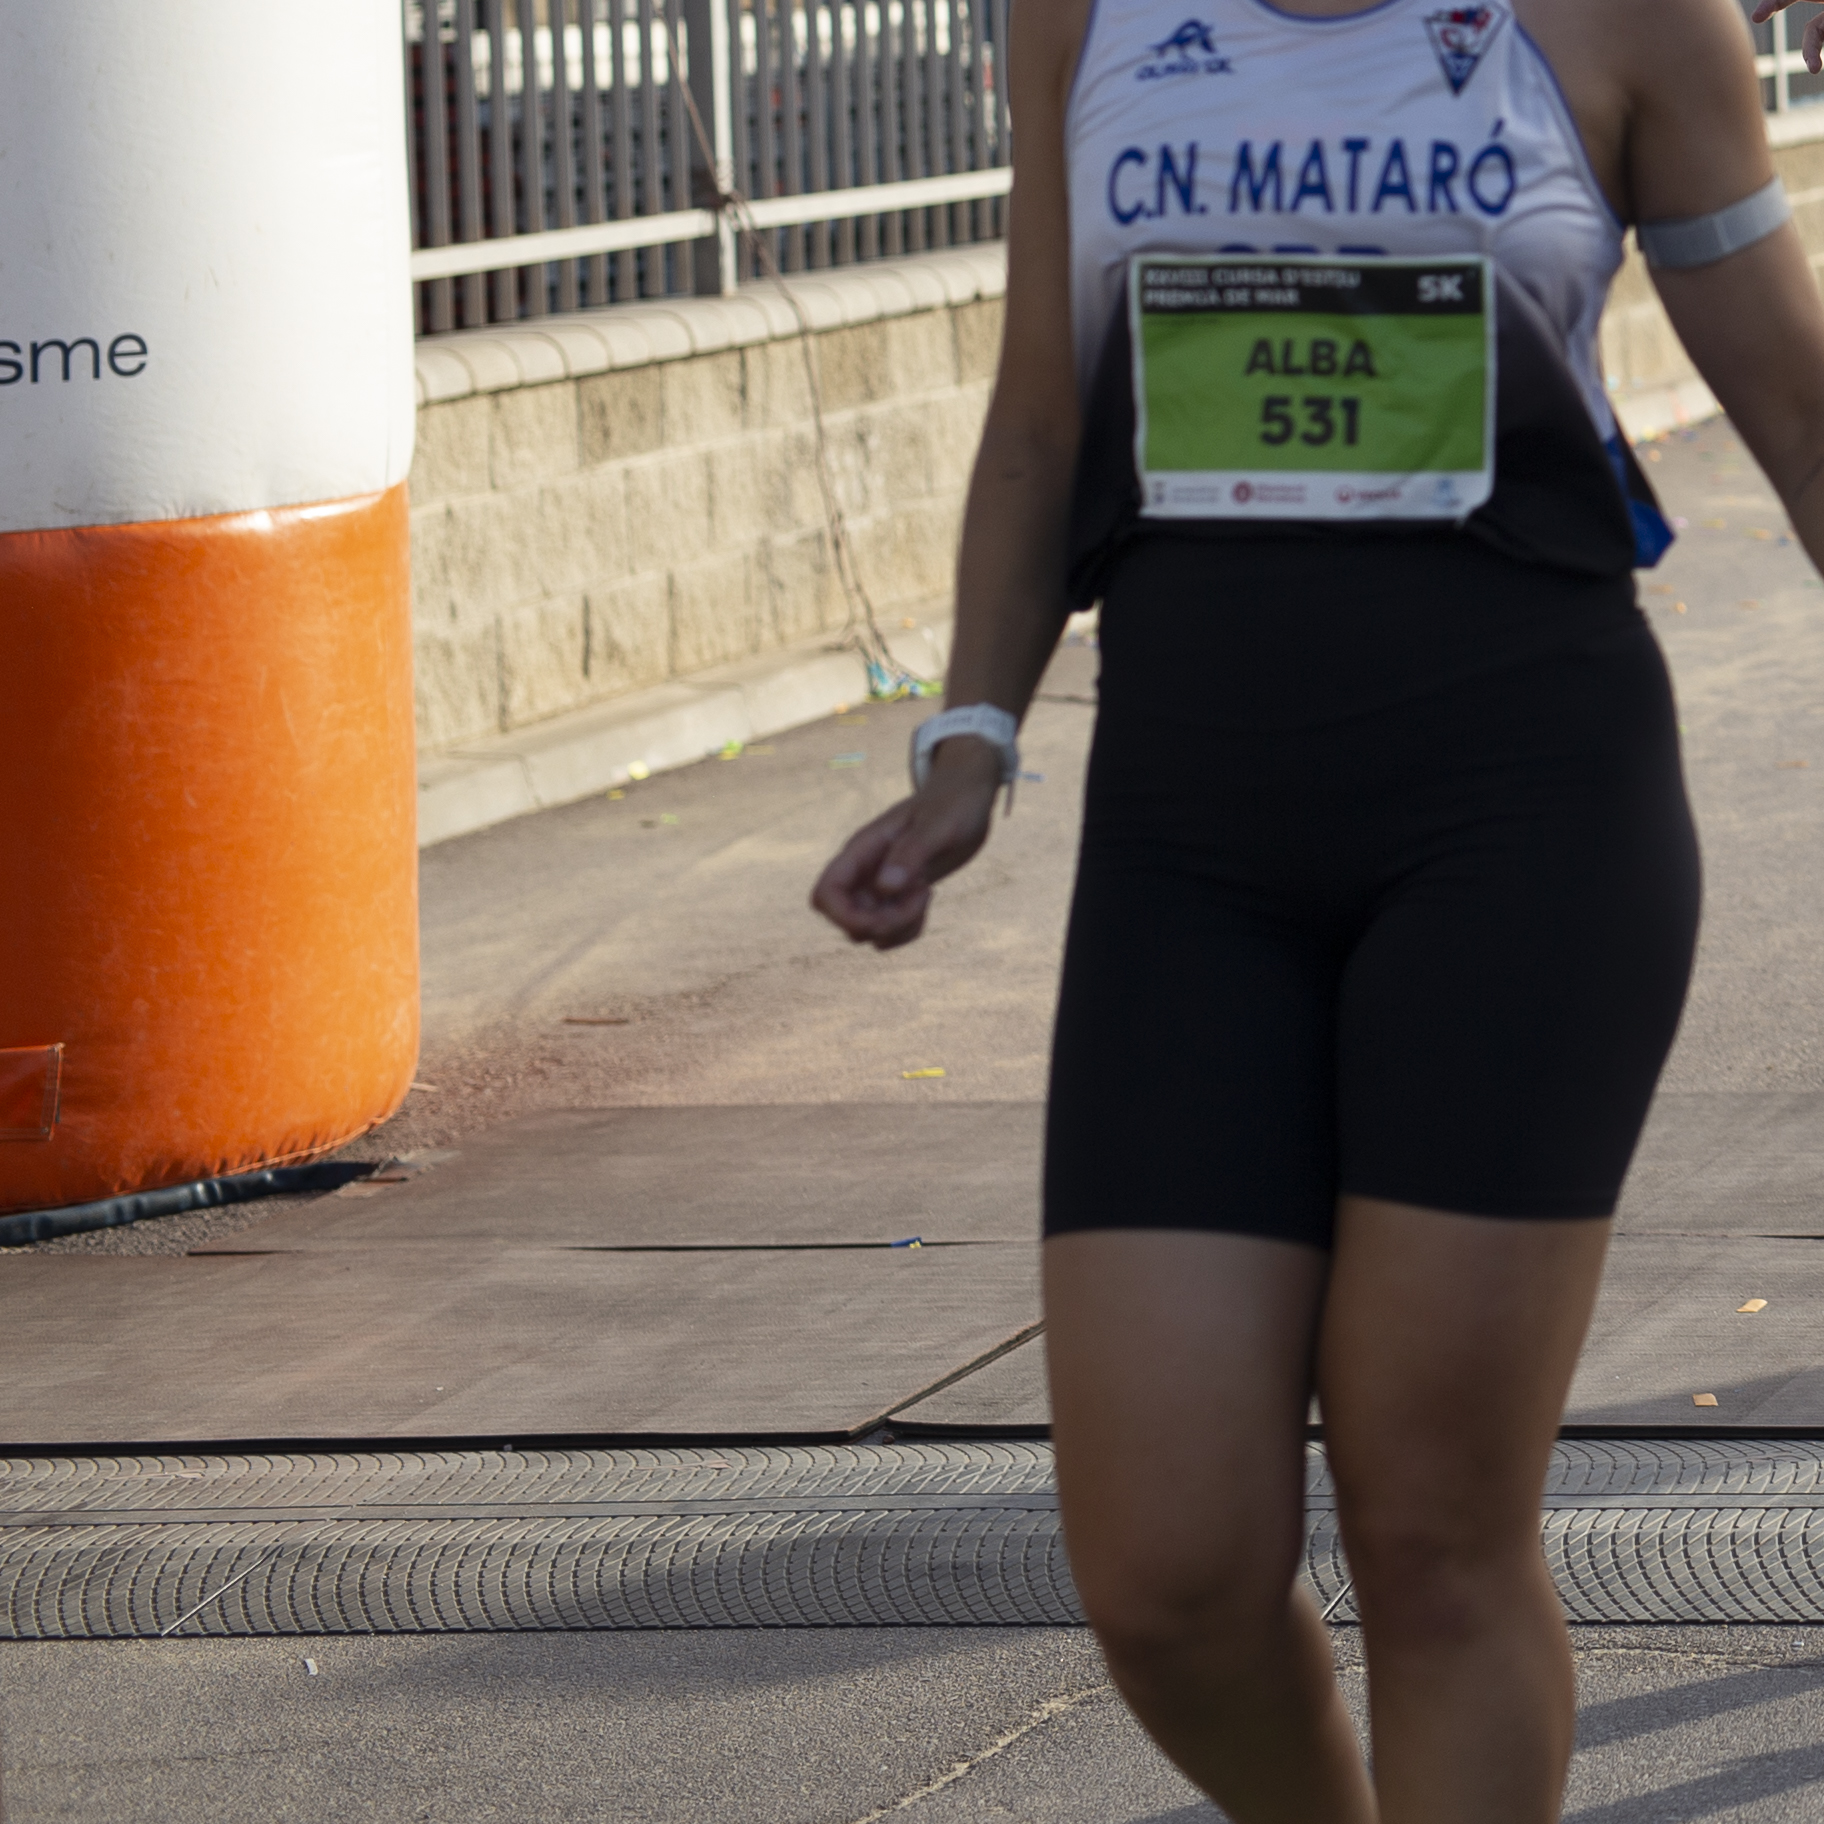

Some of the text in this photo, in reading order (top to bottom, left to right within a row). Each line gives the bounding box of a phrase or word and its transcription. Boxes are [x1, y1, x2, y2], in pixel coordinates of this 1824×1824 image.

[1108, 117, 1517, 226] C.N. MATARÓ
[1417, 275, 1465, 303] 5K
[1246, 338, 1377, 377] ALBA
[1260, 395, 1359, 447] 531
